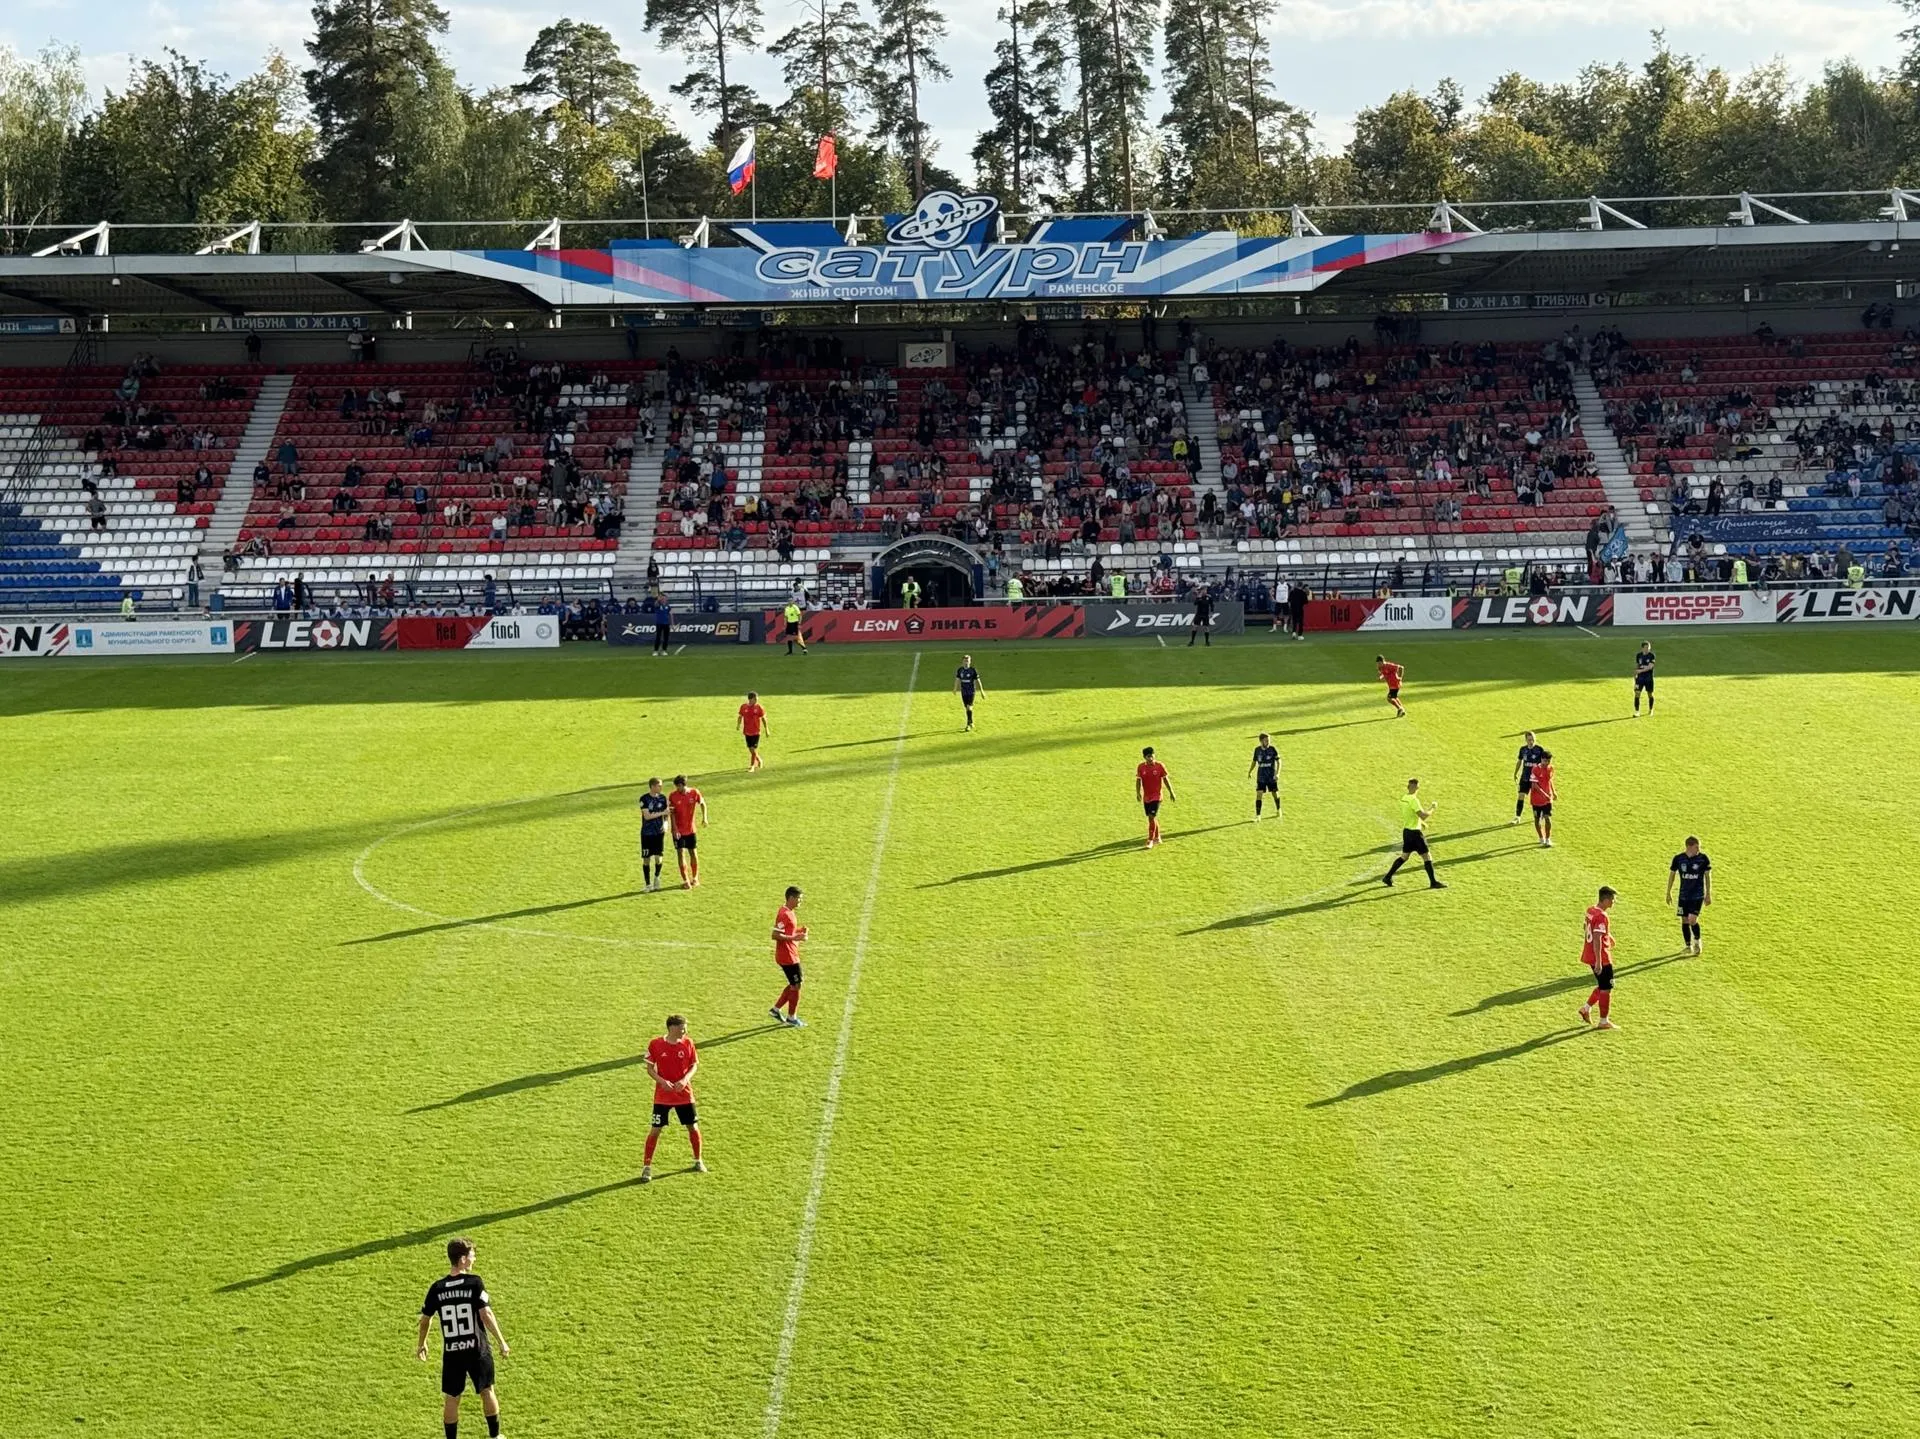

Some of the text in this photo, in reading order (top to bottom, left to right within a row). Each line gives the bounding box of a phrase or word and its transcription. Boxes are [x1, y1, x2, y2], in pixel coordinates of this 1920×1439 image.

[790, 286, 898, 299] ЖИВИ СПОРТОМ!
[1048, 283, 1125, 294] РАМЕНСКОЕ
[1455, 296, 1521, 309] ЮЖНАЯ
[1535, 294, 1587, 306] ТРИБУНА
[234, 317, 287, 329] ТРИБУНА
[295, 317, 362, 329] ЮЖНАЯ
[1645, 595, 1741, 609] МОСОБЛ
[1802, 589, 1917, 618] LEON
[1330, 602, 1414, 624] Red finch
[1477, 596, 1590, 625] LEON
[1645, 608, 1720, 621] СПОРТ
[436, 621, 520, 642] Red finch
[853, 619, 900, 632] LEON
[930, 618, 997, 631] ЛИГА Б
[259, 619, 372, 649] LEON
[440, 1303, 475, 1338] 99
[445, 1339, 476, 1352] LEON
